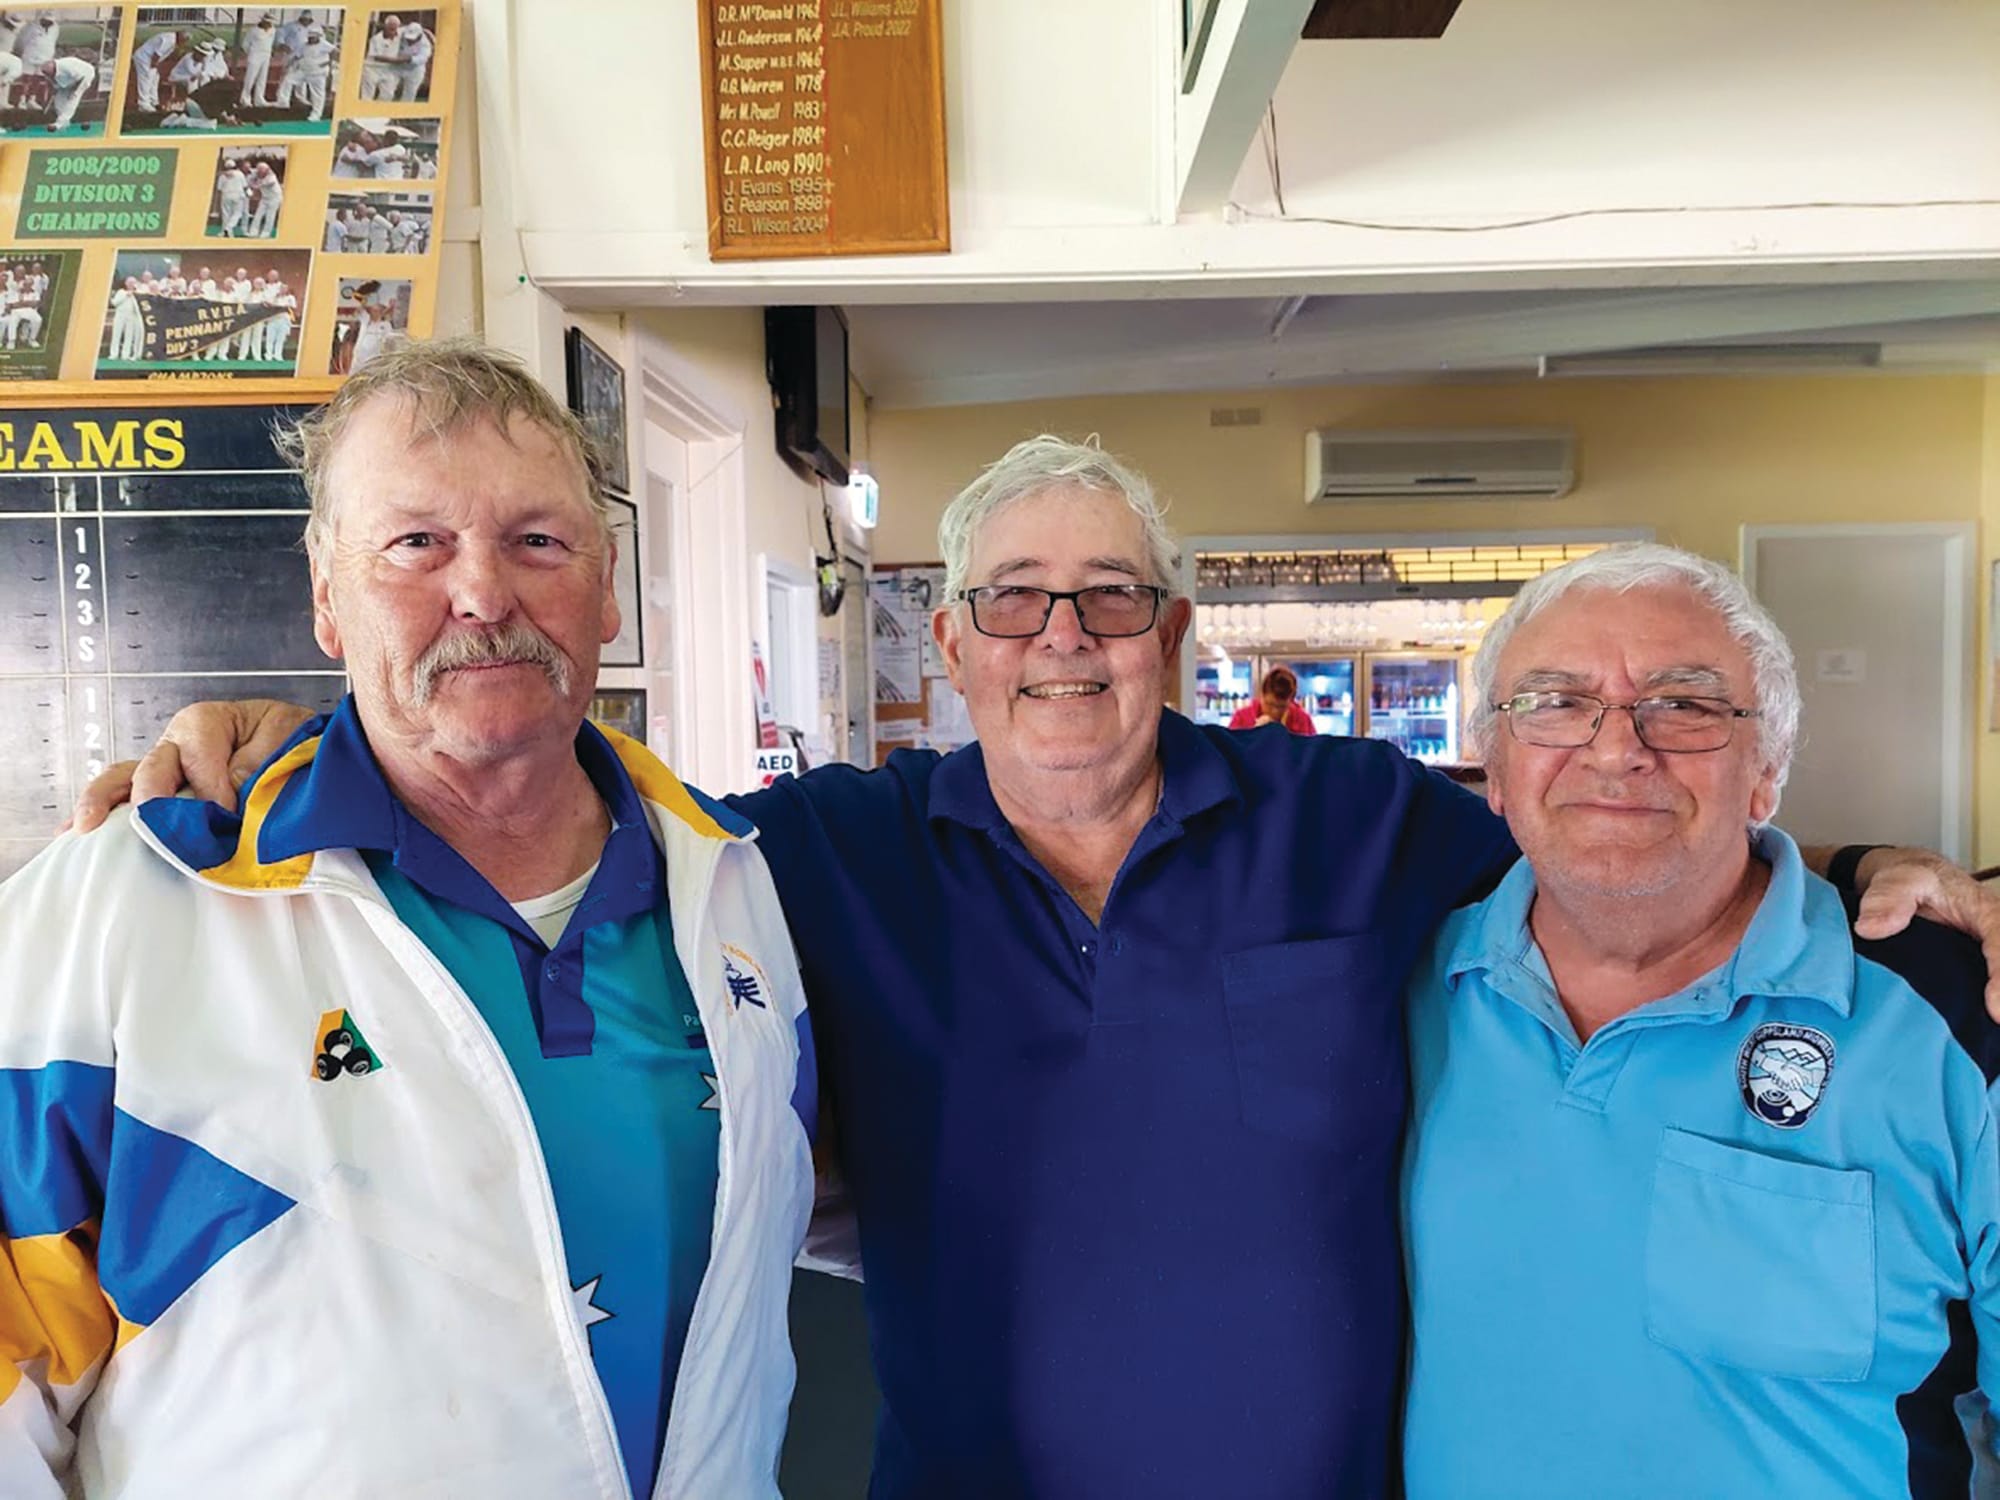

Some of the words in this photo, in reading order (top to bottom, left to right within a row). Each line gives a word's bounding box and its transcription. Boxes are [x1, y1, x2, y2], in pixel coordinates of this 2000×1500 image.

[793, 101, 820, 119] 1983
[792, 125, 822, 147] 1984
[45, 156, 160, 177] 2008/2009
[793, 152, 823, 174] 1990
[35, 184, 136, 203] DIVISION
[140, 184, 155, 203] 3
[741, 179, 783, 195] Evans
[789, 176, 823, 194] 1995
[740, 196, 789, 214] Pearson
[793, 195, 823, 212] 1998
[26, 212, 160, 231] CHAMPIONS
[751, 217, 789, 234] Wilson
[165, 319, 235, 340] PENNANT
[165, 341, 188, 354] DIV
[190, 340, 199, 350] 3
[74, 527, 87, 554] 1
[74, 563, 92, 589] 2
[77, 600, 94, 626] 3
[78, 636, 95, 662] S
[85, 687, 95, 713] 1
[84, 722, 101, 749] 2
[757, 755, 793, 770] AED
